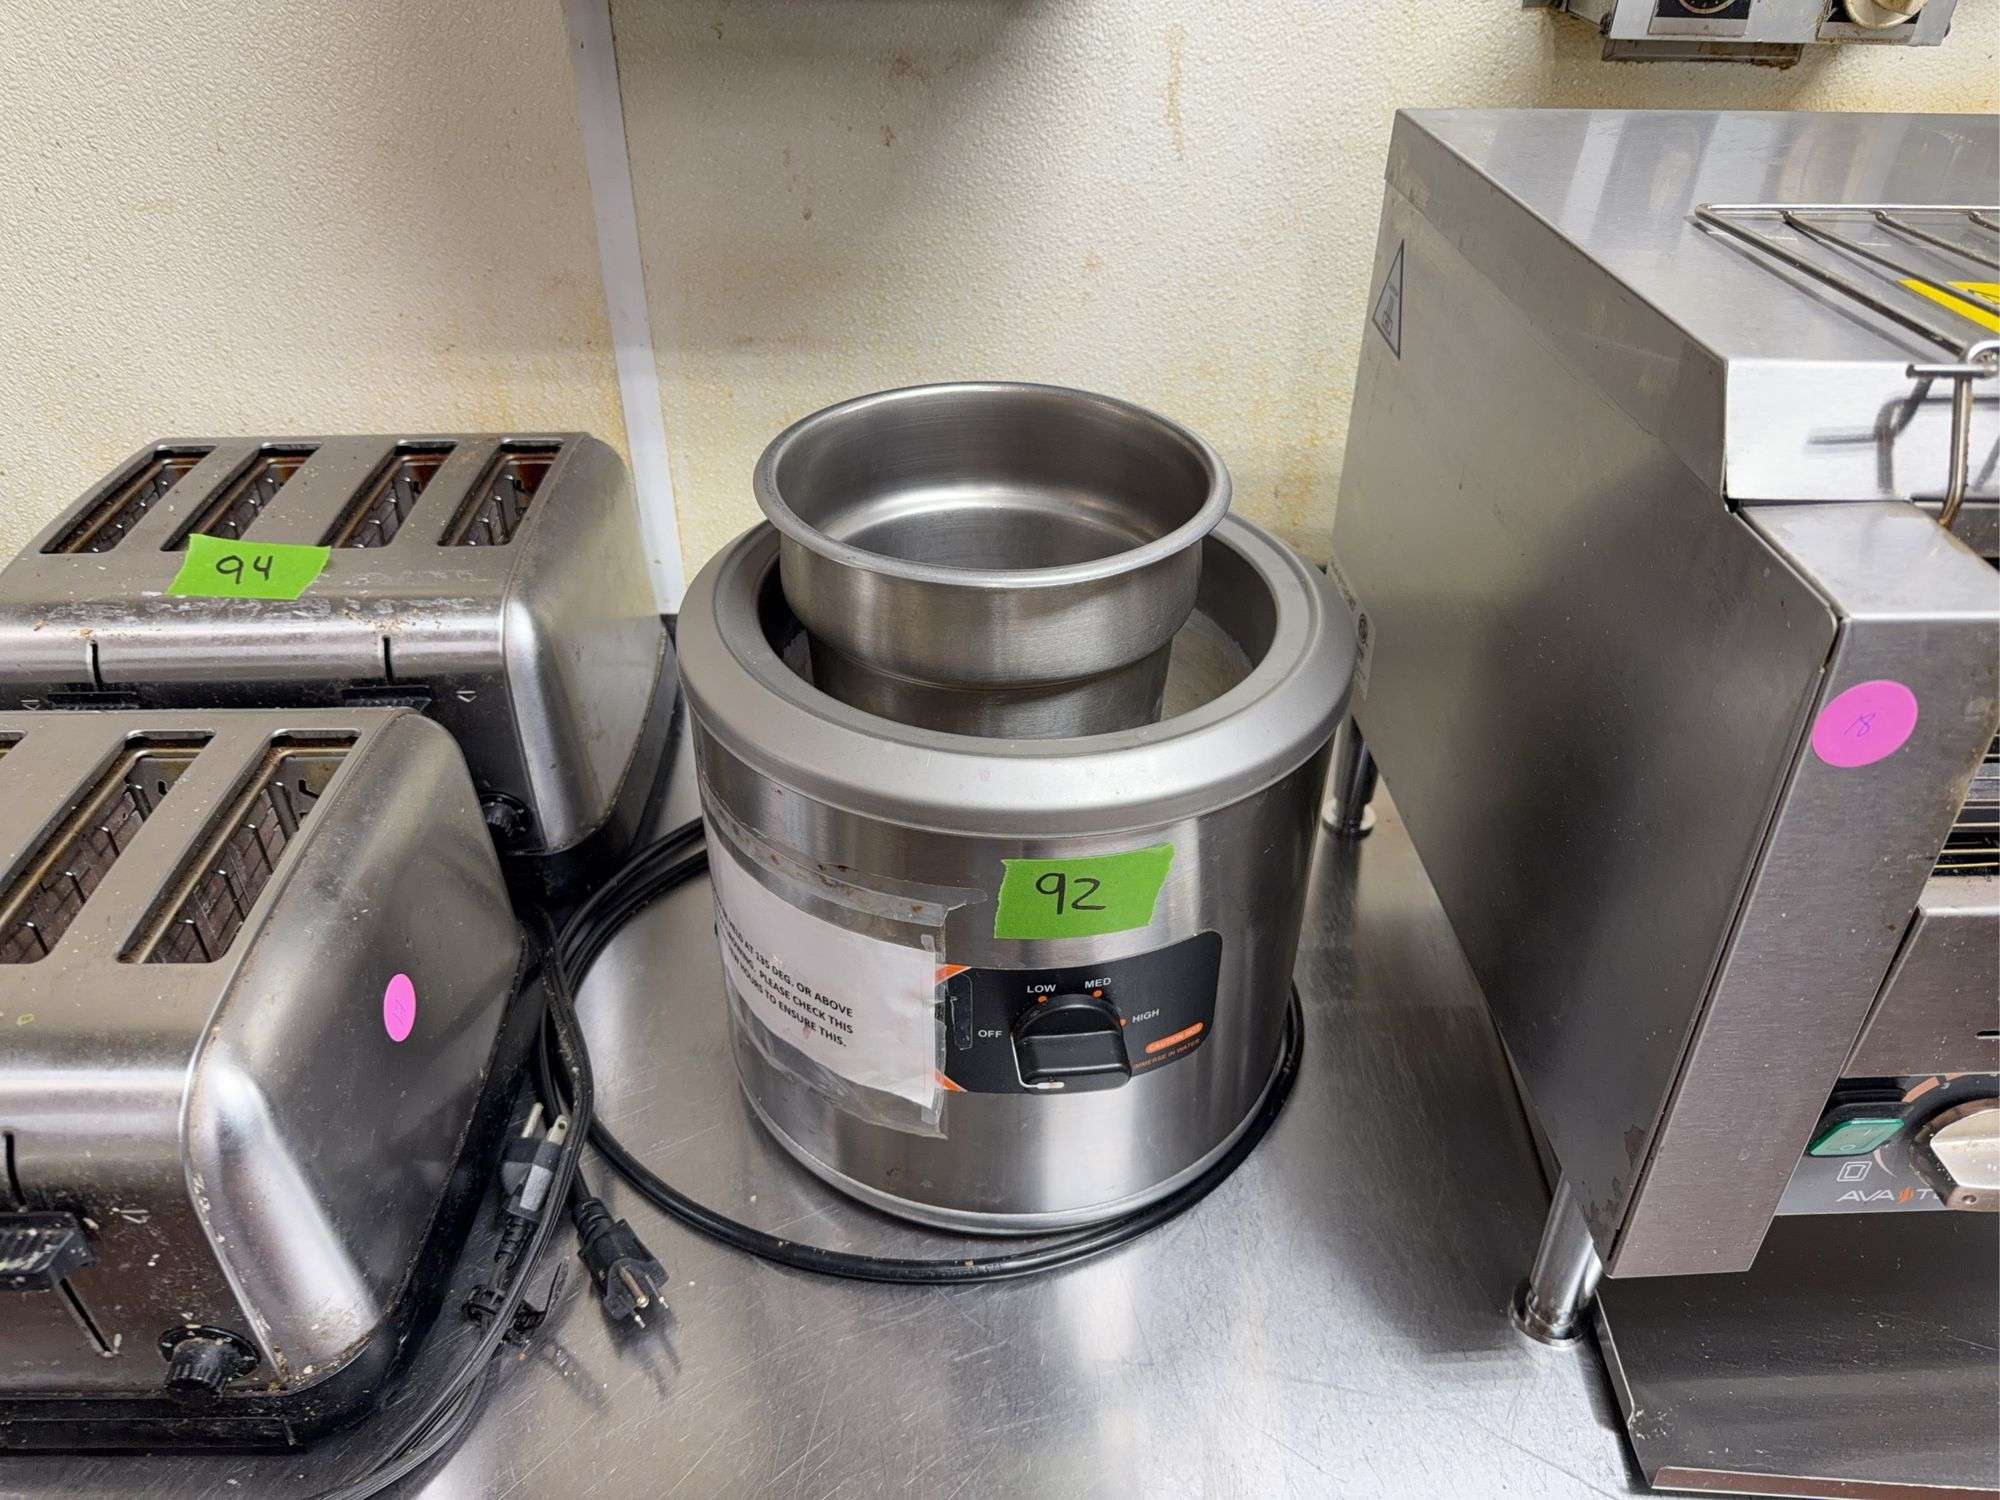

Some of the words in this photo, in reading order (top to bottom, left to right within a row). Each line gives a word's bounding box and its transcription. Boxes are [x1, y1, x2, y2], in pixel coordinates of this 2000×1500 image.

[216, 555, 273, 585] 94
[1035, 871, 1107, 916] 92
[771, 965, 794, 987] DEG.
[796, 982, 812, 997] OR
[814, 992, 854, 1018] ABOVE
[1026, 983, 1057, 994] LOW
[1084, 977, 1112, 989] MED
[759, 969, 791, 1000] PLEASE
[792, 995, 826, 1020] CHECK
[828, 1014, 854, 1034] THIS
[1131, 1008, 1160, 1023] HIGH
[764, 988, 777, 1004] TO
[778, 1001, 817, 1031] ENSURE
[819, 1026, 847, 1047] THIS.
[977, 1029, 1003, 1038] OFF
